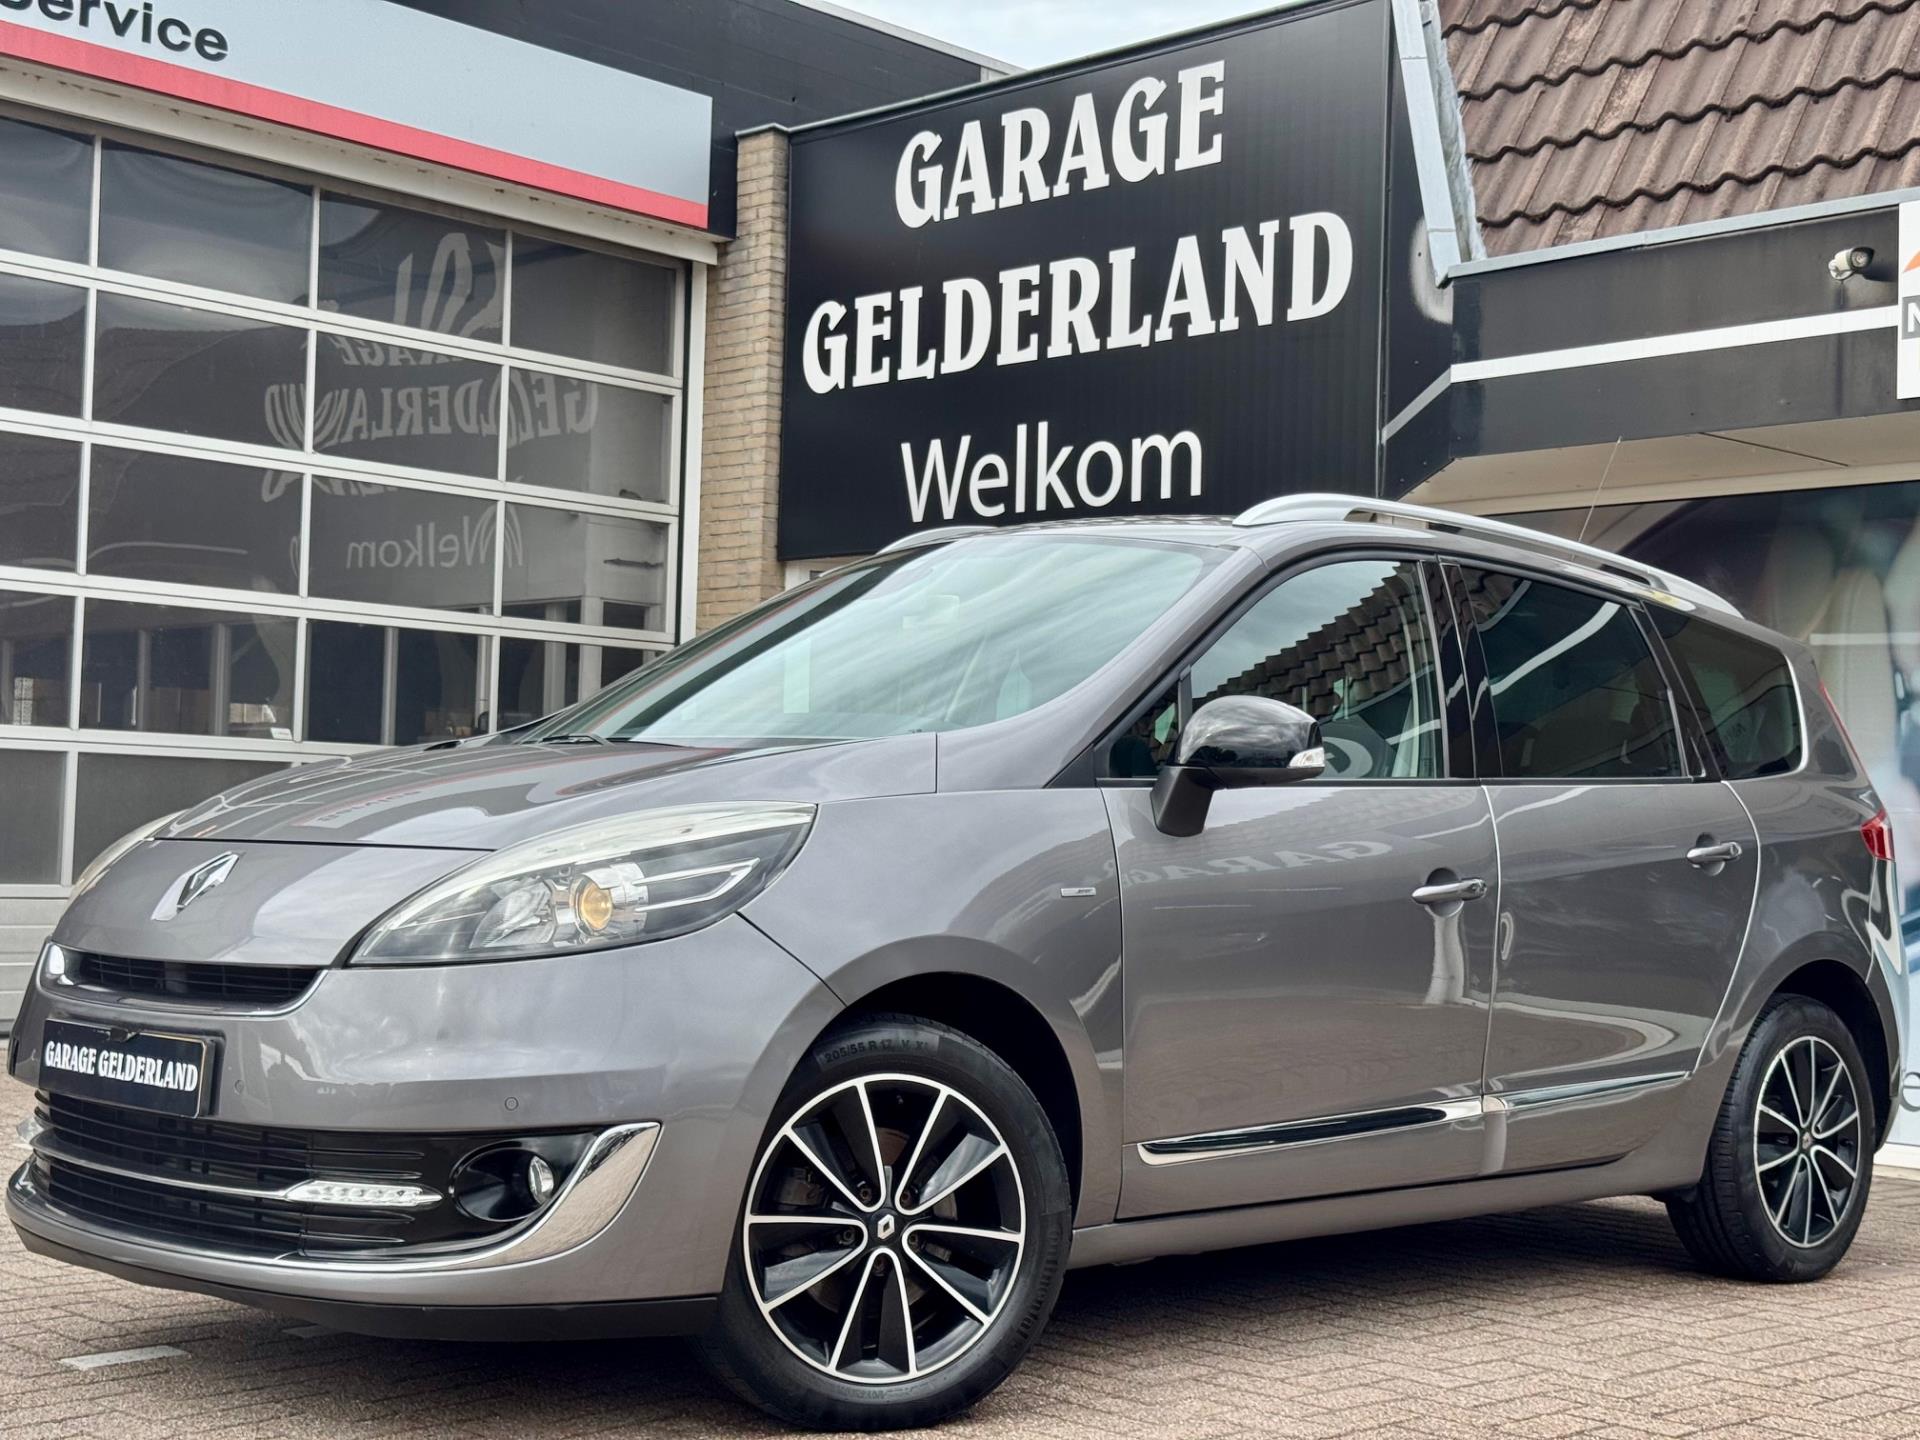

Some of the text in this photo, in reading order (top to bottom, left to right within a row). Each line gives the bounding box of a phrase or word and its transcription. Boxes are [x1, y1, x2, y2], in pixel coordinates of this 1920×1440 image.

[895, 60, 1225, 228] GARAGE
[802, 211, 1353, 394] GELDERLAND
[901, 421, 1201, 523] Welkom
[45, 1040, 199, 1092] GARAGE GELDERLAND
